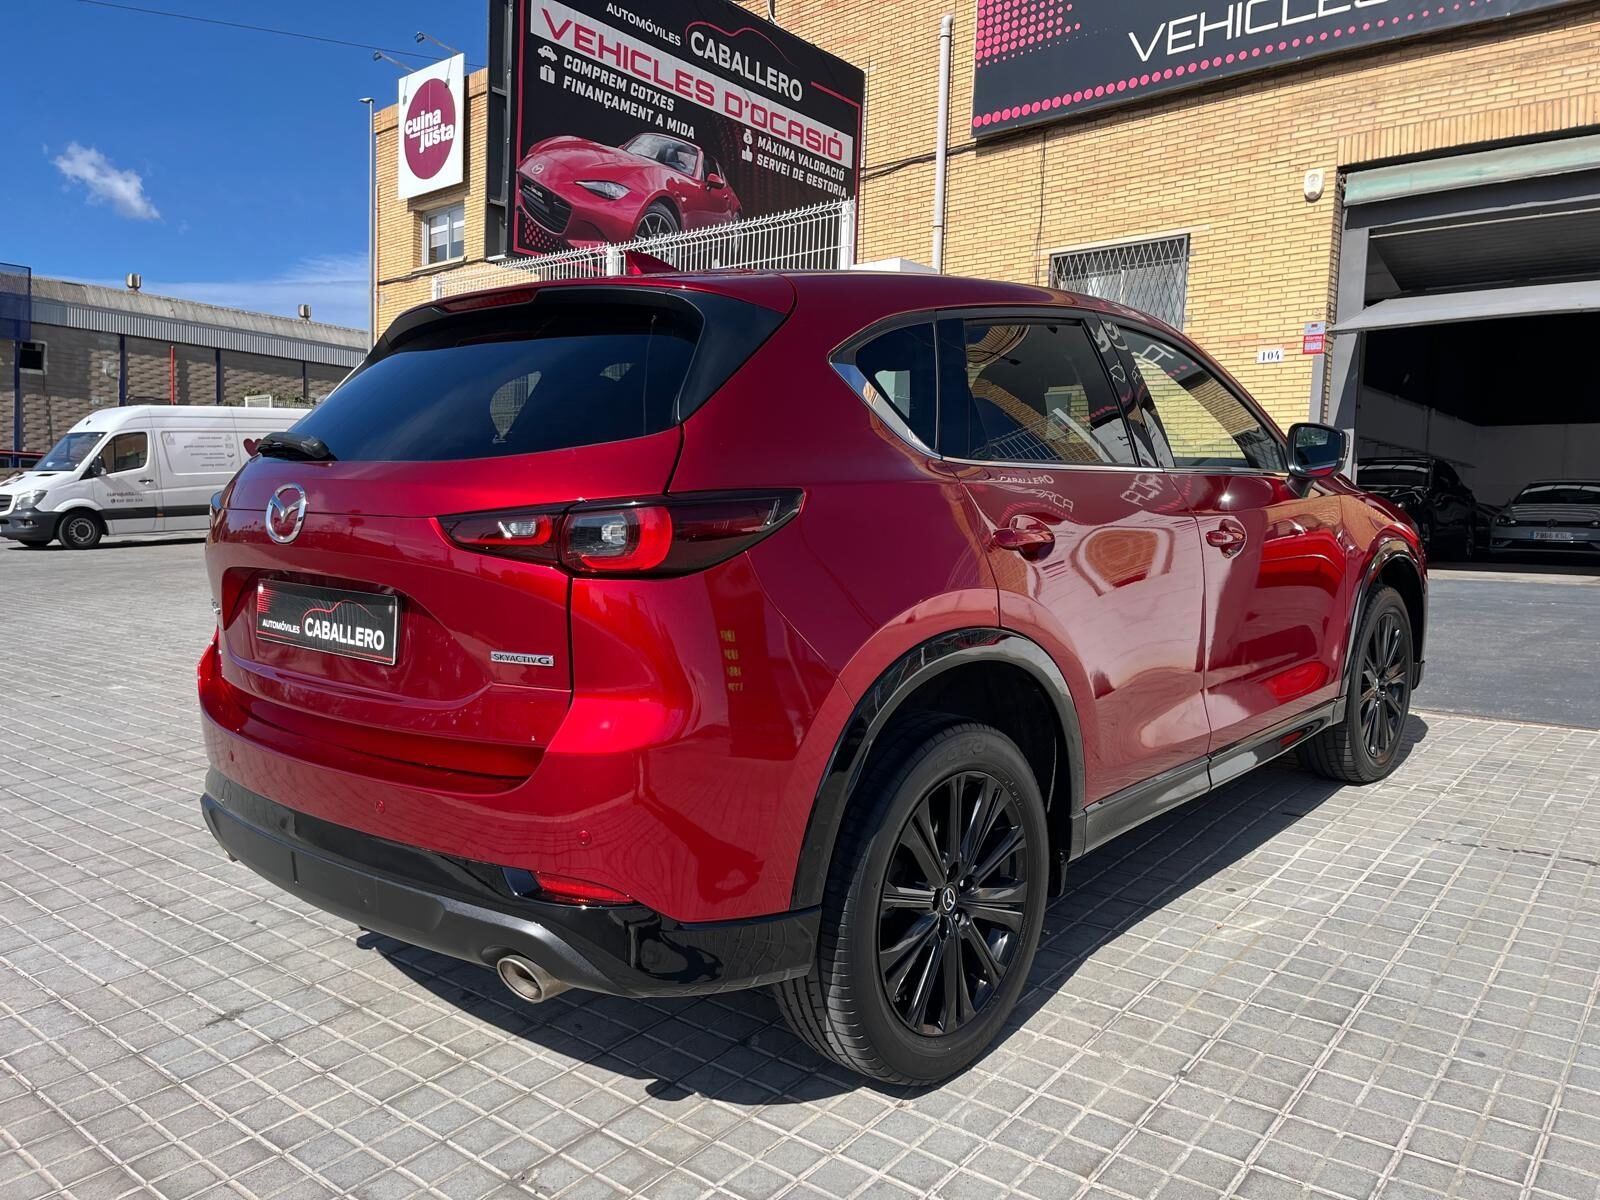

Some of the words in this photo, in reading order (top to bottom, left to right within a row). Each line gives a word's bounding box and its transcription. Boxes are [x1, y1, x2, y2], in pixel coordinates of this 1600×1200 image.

[606, 3, 681, 46] AUTOMÓVILES
[690, 31, 803, 102] CABALLERO
[1128, 0, 1389, 62] VEHICL
[541, 8, 715, 106] VEHICLES
[724, 91, 843, 161] D'OCASIÓ
[563, 54, 627, 92] COMPREM
[630, 82, 675, 111] COTXES
[405, 109, 442, 136] cuina
[563, 75, 654, 122] FINANÇAMENT
[655, 113, 664, 127] A
[666, 117, 695, 139] MIDA
[419, 123, 454, 154] justa
[757, 136, 795, 162] MÀXIMA
[798, 153, 845, 181] VALORACIÓ
[756, 153, 790, 176] SERVEI
[792, 167, 805, 182] DE
[806, 172, 847, 198] GESTORIA
[1262, 350, 1280, 361] 104
[262, 619, 300, 634] AUTOMÓVILES
[304, 617, 385, 651] CABALLERO
